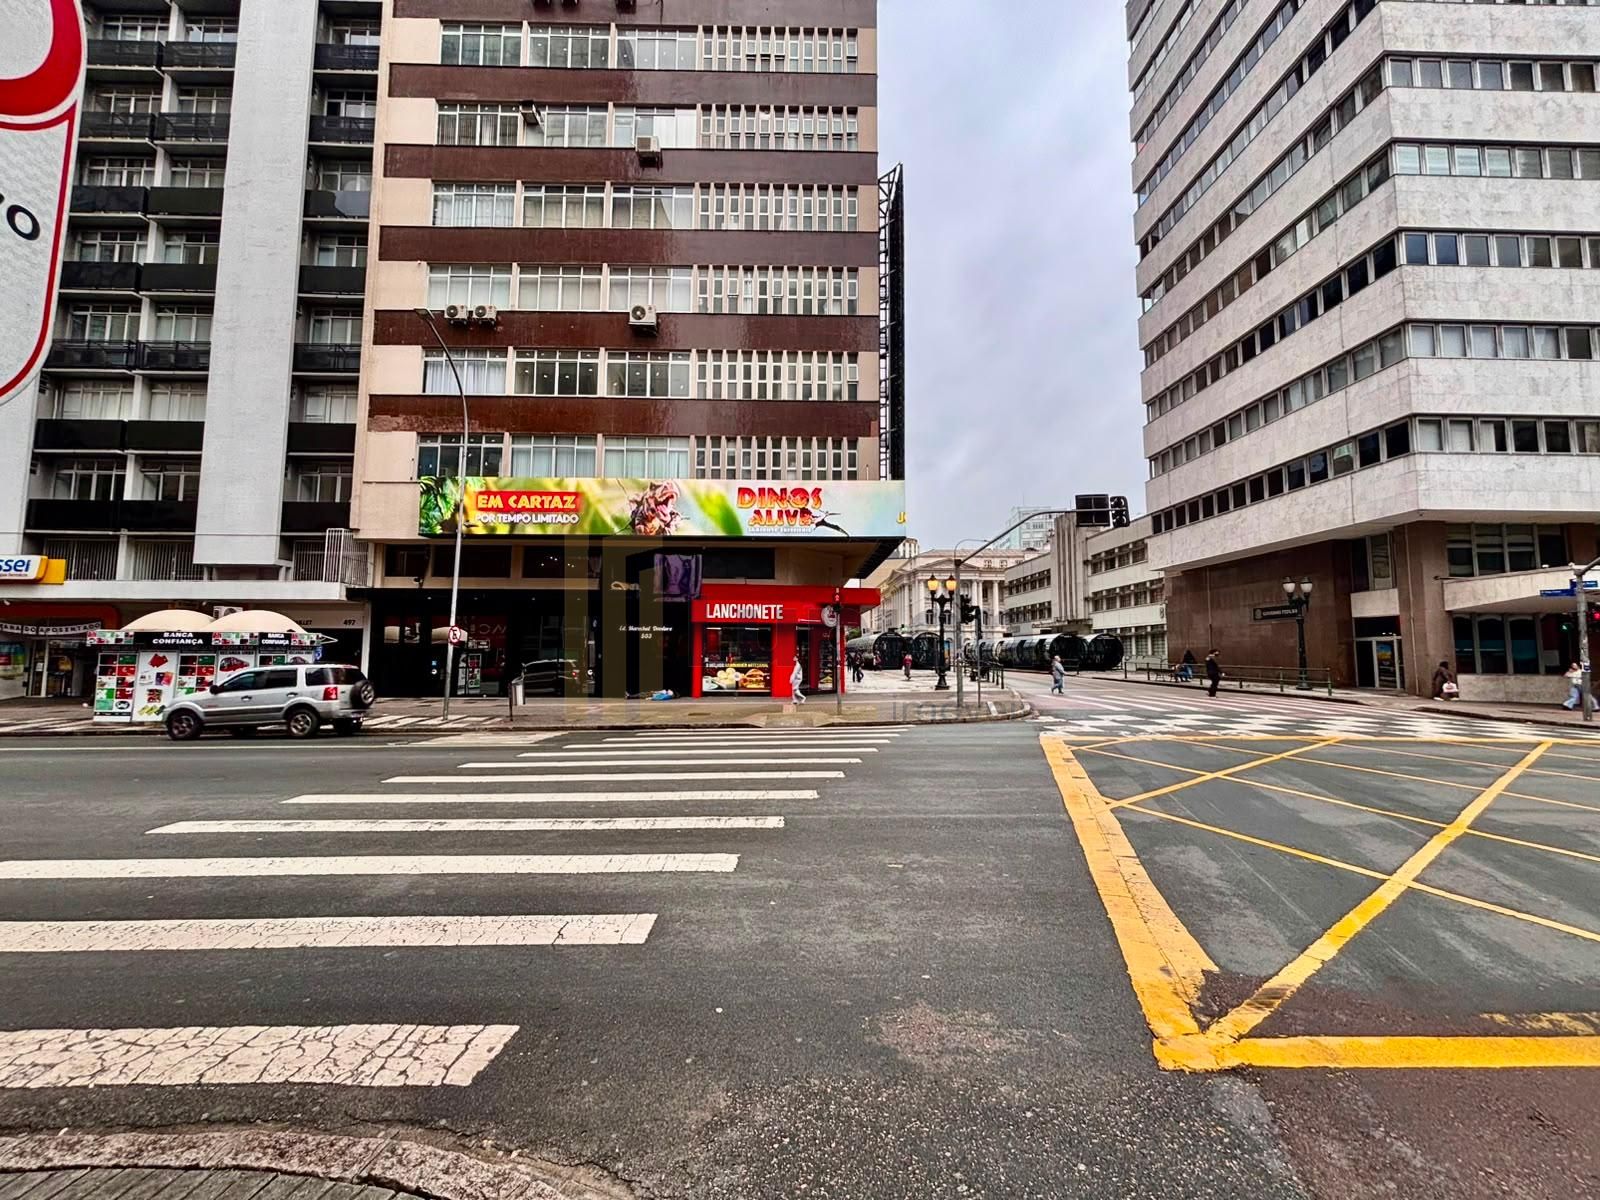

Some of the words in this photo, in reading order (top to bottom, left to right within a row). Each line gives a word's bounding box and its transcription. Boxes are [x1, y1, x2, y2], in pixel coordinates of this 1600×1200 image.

[477, 495, 503, 509] EM
[508, 495, 576, 509] CARTAZ
[737, 487, 822, 509] DINOS
[475, 513, 496, 524] POR
[497, 513, 531, 524] TEMPO
[532, 513, 579, 524] LIMITADO
[748, 509, 813, 526] ALIVE
[706, 603, 784, 619] LANCHONETE
[152, 638, 204, 646] CONFIANÇA
